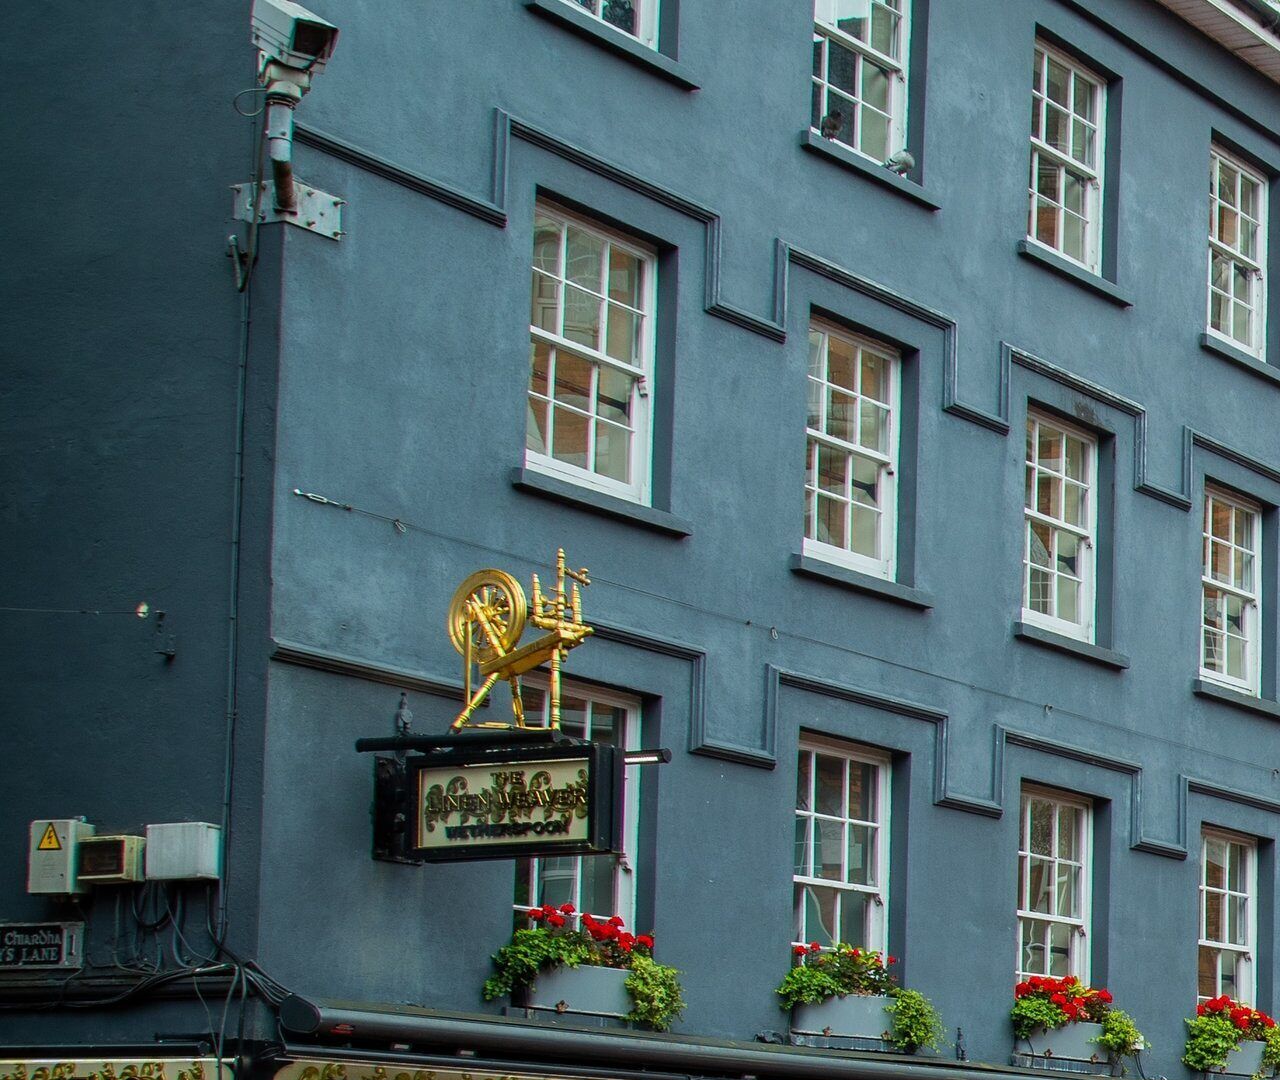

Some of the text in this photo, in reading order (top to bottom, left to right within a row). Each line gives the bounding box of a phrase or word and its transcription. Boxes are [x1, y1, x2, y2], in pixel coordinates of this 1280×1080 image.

[491, 770, 525, 787] THE
[428, 786, 587, 814] LINEN WEAVER
[22, 947, 58, 961] LANE
